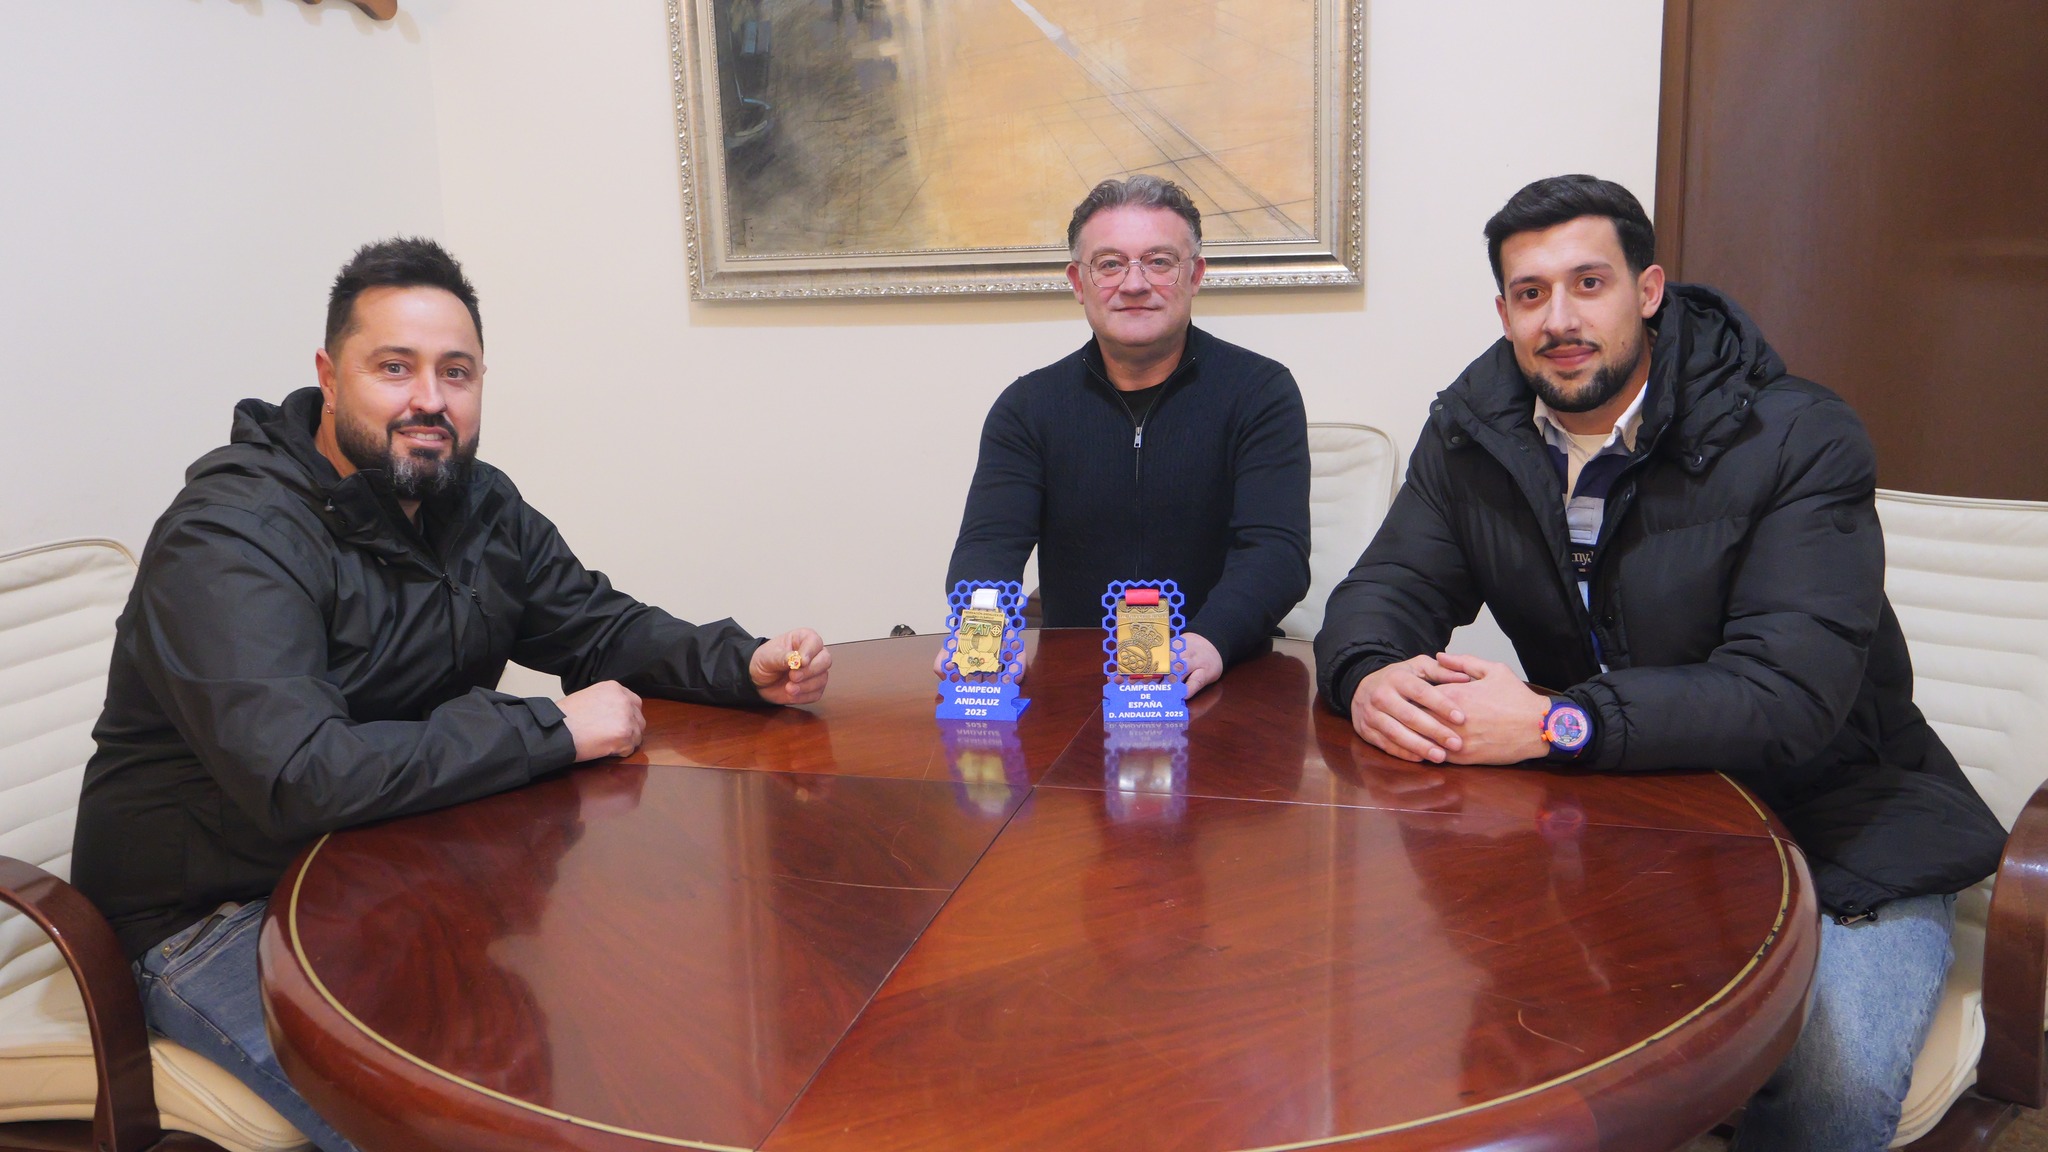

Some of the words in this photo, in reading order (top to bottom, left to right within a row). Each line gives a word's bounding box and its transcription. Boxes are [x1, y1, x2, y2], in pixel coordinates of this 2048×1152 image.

[955, 685, 1001, 694] CAMPEON
[1119, 684, 1172, 692] CAMPEONES
[954, 697, 1000, 706] ANDALUZ
[1128, 700, 1163, 709] ESPAÑA
[964, 708, 988, 716] 2025
[1118, 711, 1162, 719] ANDALUZA
